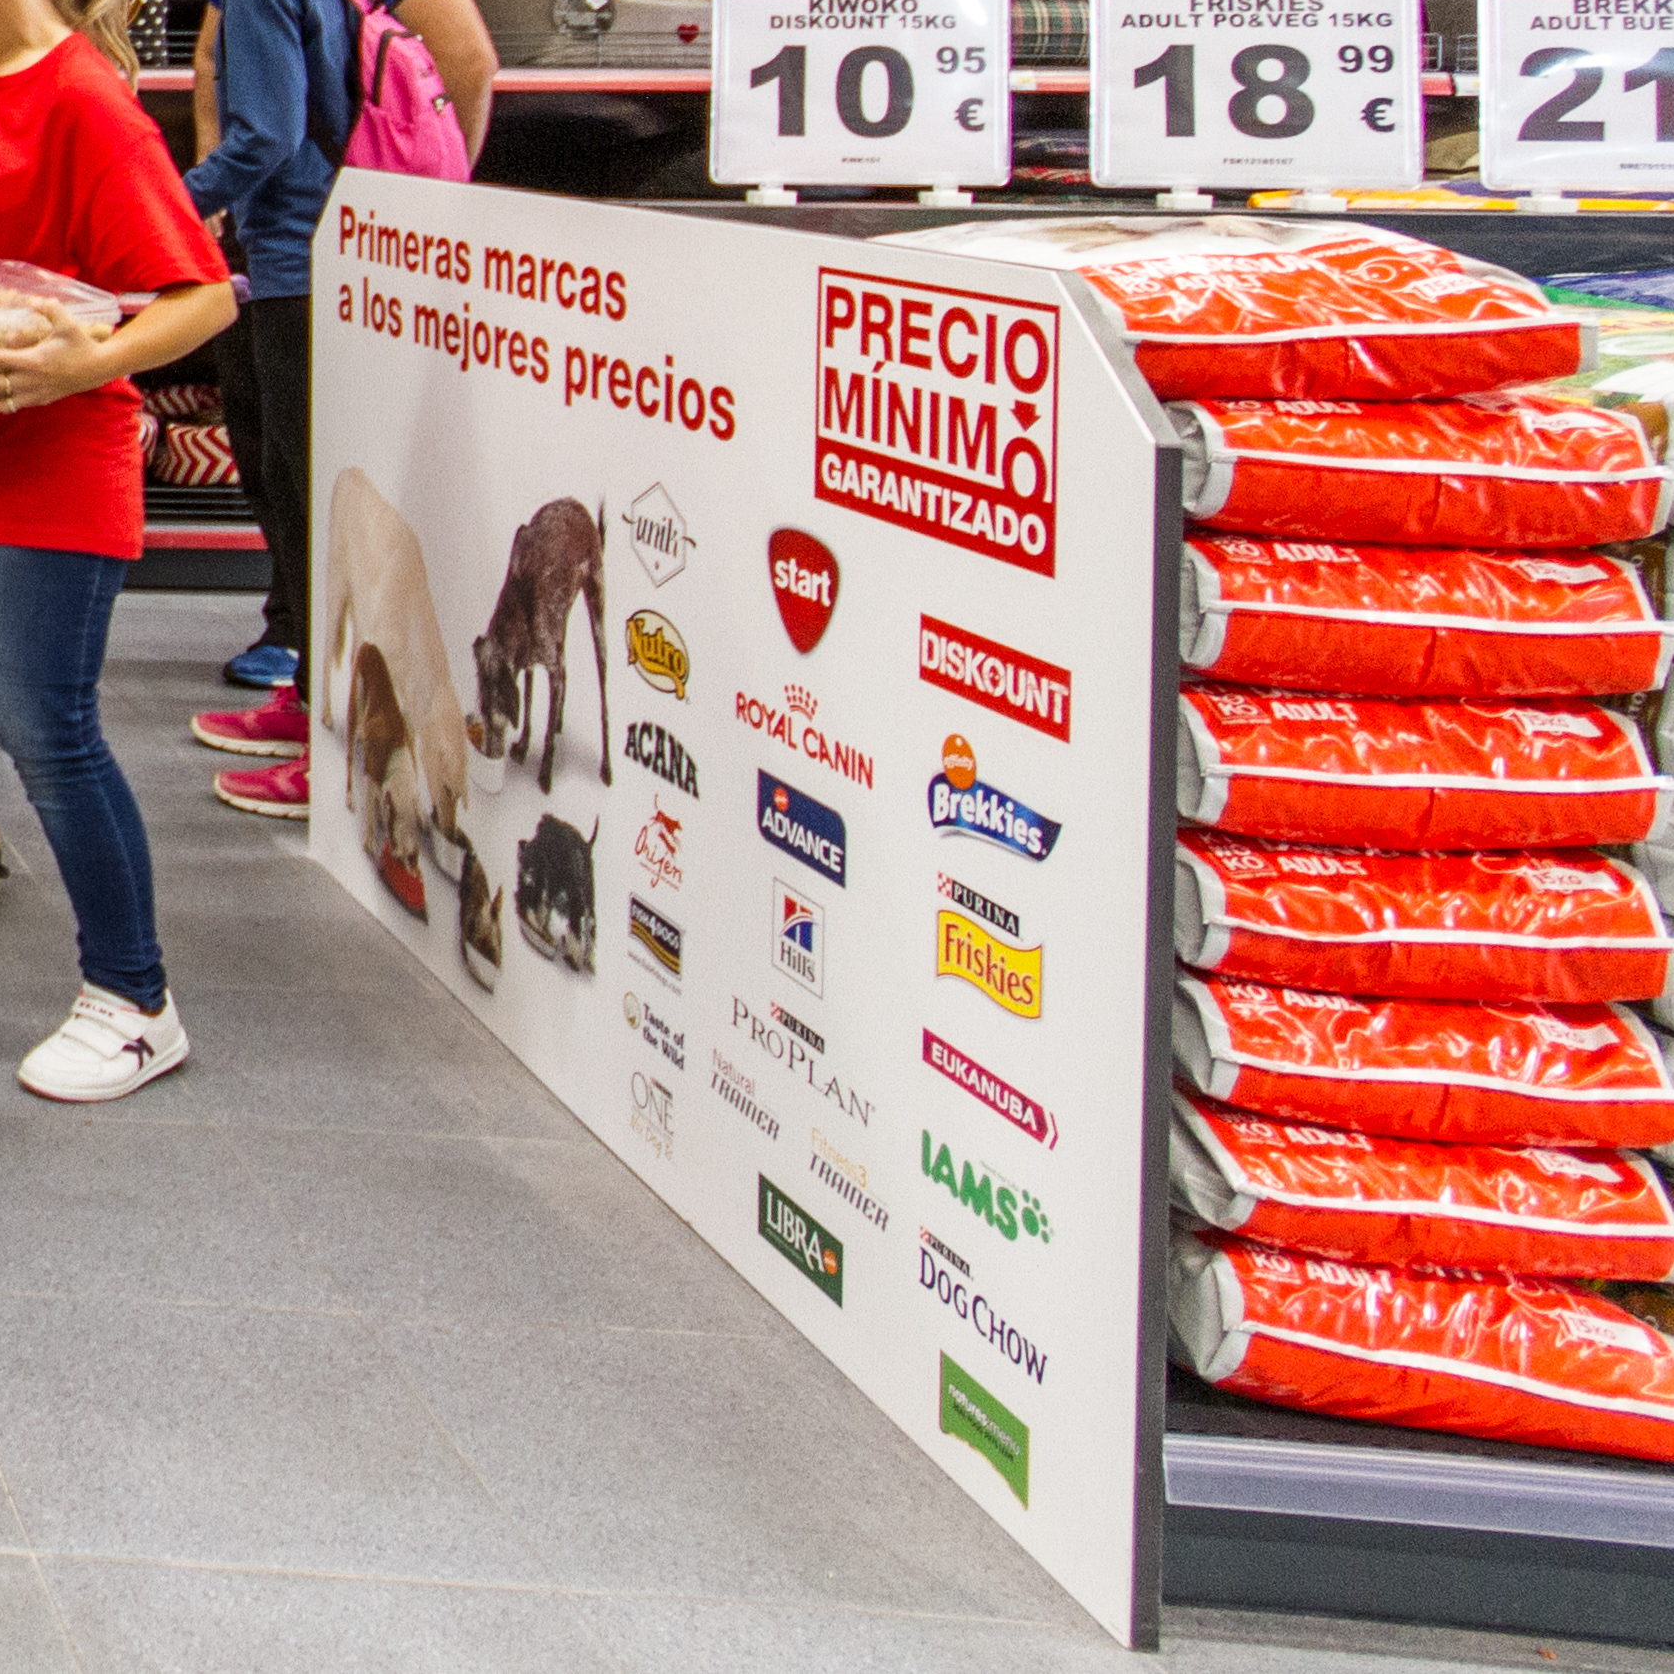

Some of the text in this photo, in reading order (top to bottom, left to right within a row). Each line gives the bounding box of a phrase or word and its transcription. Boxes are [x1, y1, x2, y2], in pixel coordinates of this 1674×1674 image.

[770, 15, 956, 29] DISKOUNT 15KG
[1121, 13, 1393, 28] ADULT PO&VEG 15KG
[1530, 15, 1614, 30] ADULT
[750, 44, 987, 139] 10 95
[954, 97, 986, 132] €
[1133, 44, 1395, 139] 18 99
[1360, 97, 1396, 133] €
[339, 205, 628, 322] Primeras marcas
[1174, 273, 1265, 291] ADULT
[339, 276, 736, 442] a los mejores precios
[824, 284, 1050, 395] PRECIO
[823, 360, 1048, 504] MÍNIMO
[1273, 399, 1363, 416] ADULT
[820, 452, 1047, 557] GARANTIZADO
[774, 557, 832, 607] start
[1223, 542, 1362, 564] KO ADULT
[626, 617, 688, 696] Nutro
[921, 628, 1069, 725] DISKOUNT
[735, 691, 874, 790] ROYAL CANIN
[1222, 701, 1260, 717] KO
[1271, 701, 1359, 723] ADULT
[624, 721, 700, 800] ACANA
[761, 806, 844, 874] ADVANCE
[932, 782, 1044, 854] Brekkies
[1229, 855, 1265, 870] KO
[1276, 855, 1367, 876] ADULT
[953, 881, 1019, 936] PURINA
[780, 940, 816, 984] Hill's
[944, 922, 1035, 1005] Friskies
[643, 1002, 685, 1049] Taste of
[1231, 984, 1268, 1001] KO
[1282, 988, 1371, 1014] ADULT
[643, 1025, 684, 1071] the Wild
[712, 1047, 755, 1097] Natural
[631, 1071, 674, 1136] ONE
[711, 1072, 780, 1142] TRAINER
[931, 1041, 1038, 1131] EUKANUBA
[1232, 1123, 1374, 1152] KO ADULT
[809, 1152, 889, 1232] TRAINER
[921, 1128, 1018, 1242] IAMS
[766, 1190, 826, 1273] LIBRA
[1253, 1253, 1292, 1273] KO
[1304, 1259, 1393, 1294] ADULT
[919, 1245, 1048, 1385] DOG CHOW
